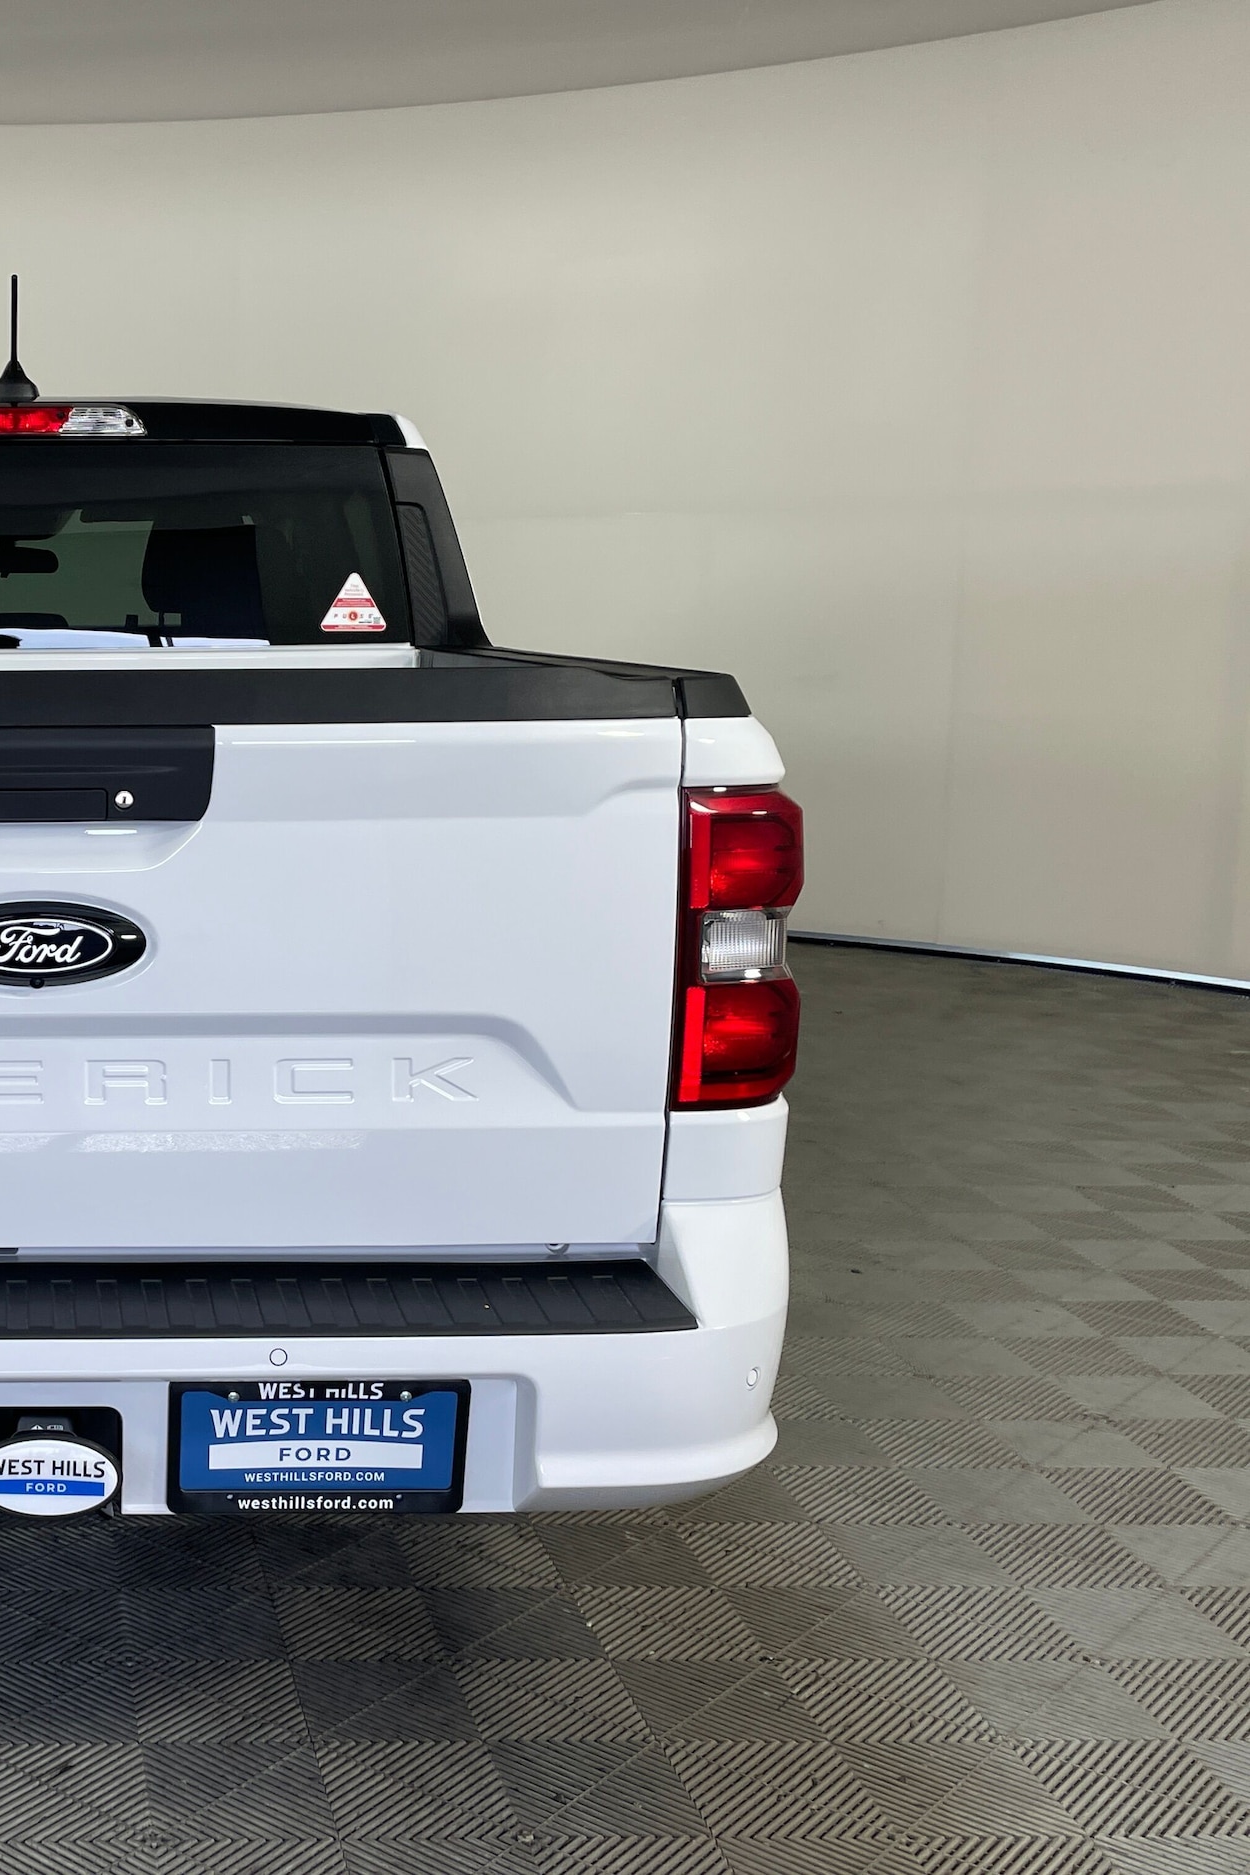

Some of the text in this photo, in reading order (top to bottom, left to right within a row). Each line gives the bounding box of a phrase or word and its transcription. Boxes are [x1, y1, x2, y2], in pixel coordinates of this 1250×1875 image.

[210, 1408, 426, 1439] WEST HILLS
[278, 1447, 352, 1462] FORD
[52, 1460, 106, 1479] HILLS
[244, 1471, 386, 1483] WESTHILLSFORD.COM
[25, 1482, 67, 1493] FORD
[237, 1495, 395, 1511] westhillsford.com
